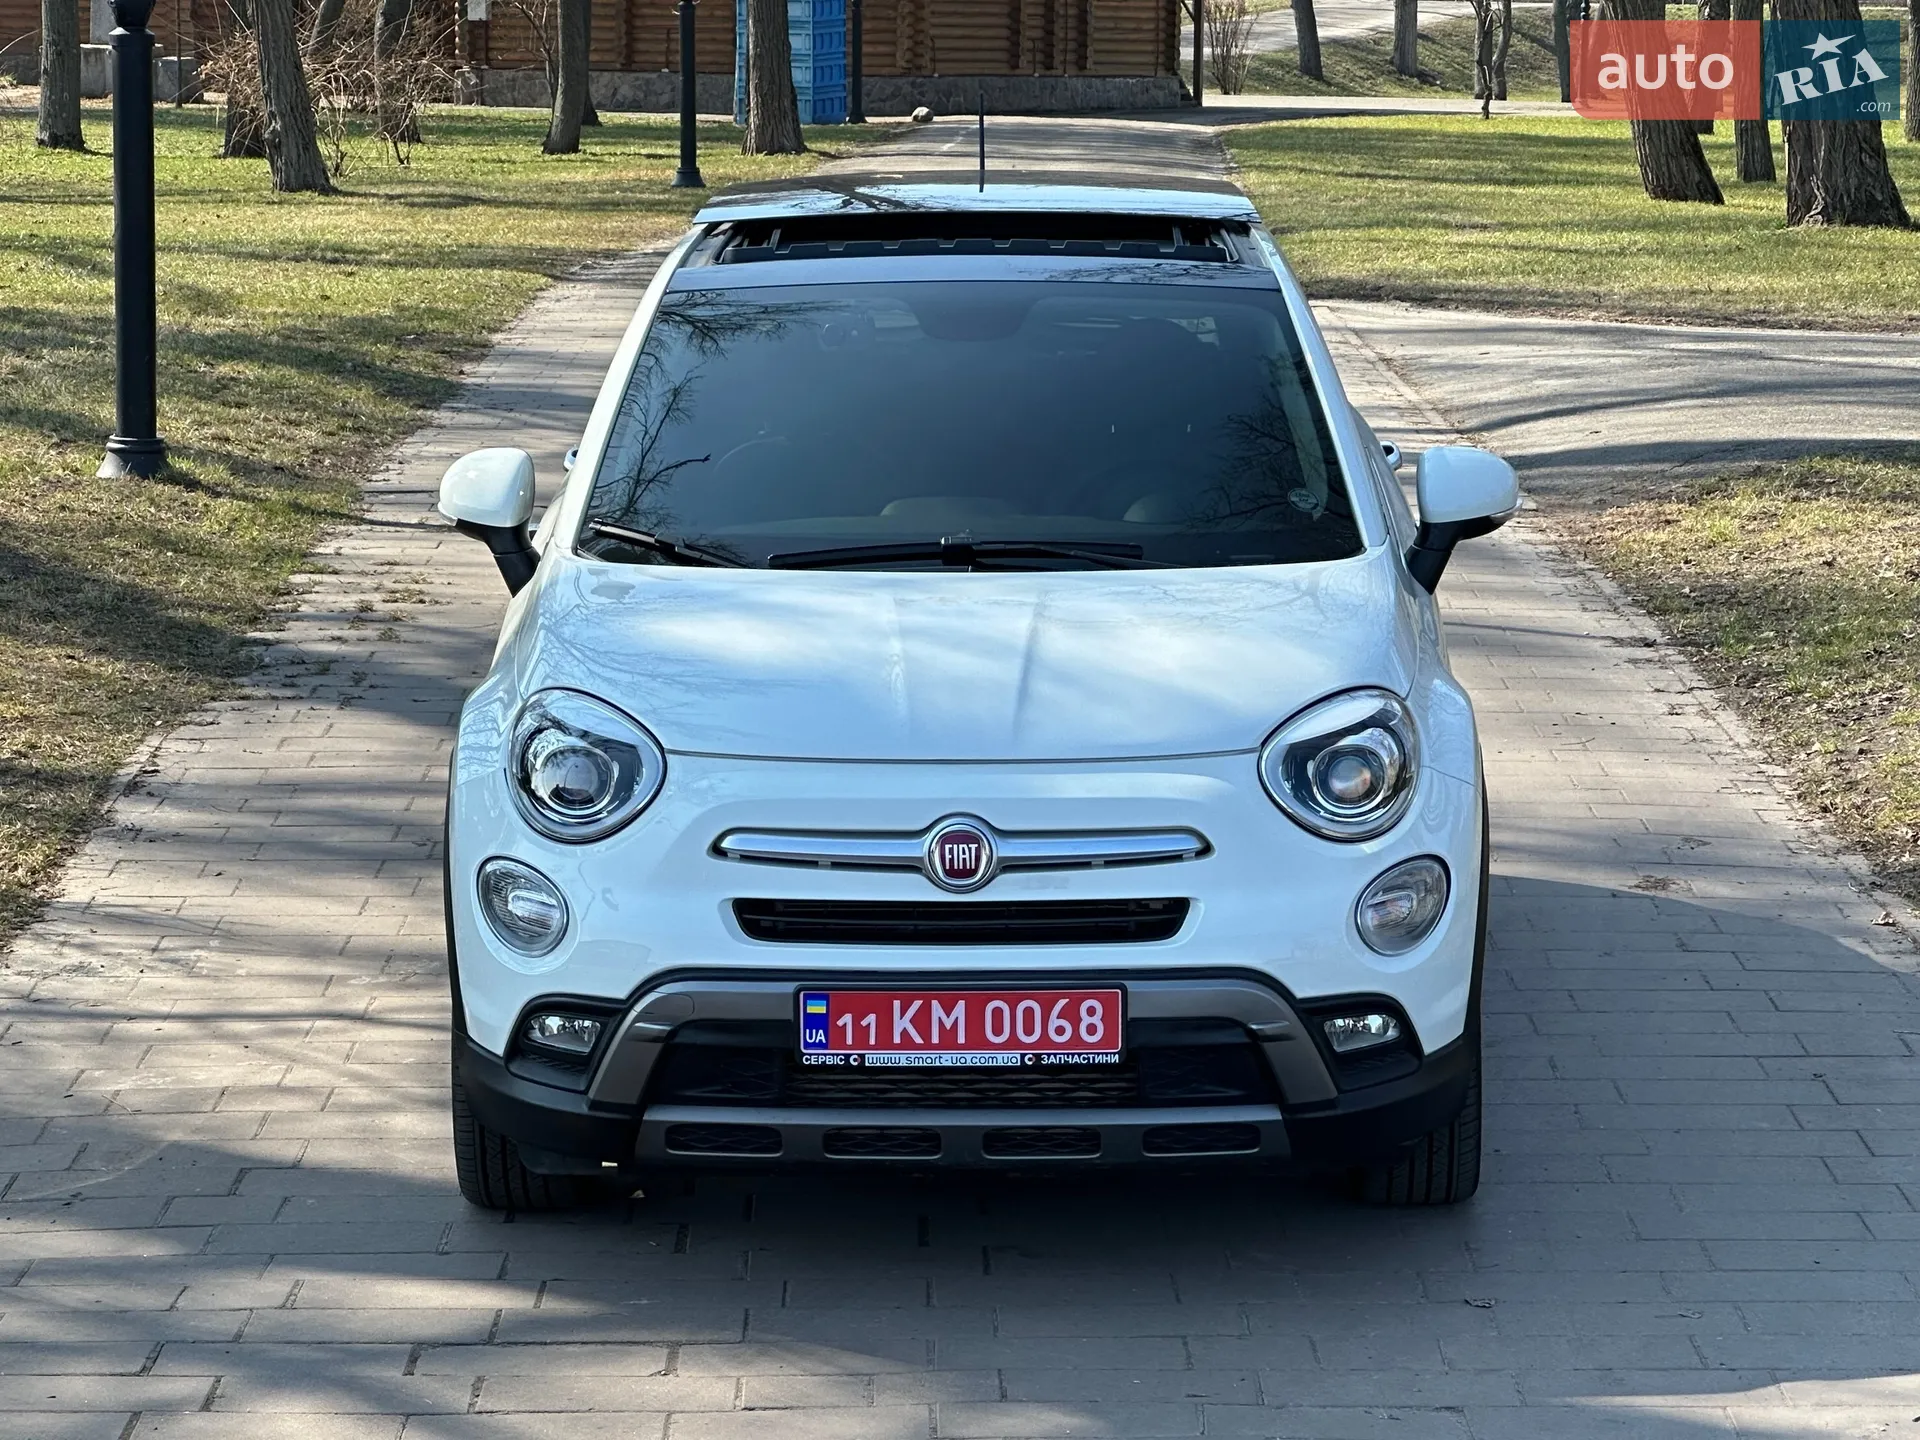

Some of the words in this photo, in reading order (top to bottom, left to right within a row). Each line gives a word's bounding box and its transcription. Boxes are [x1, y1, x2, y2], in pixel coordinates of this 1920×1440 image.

[944, 843, 978, 870] FIAT
[836, 1013, 877, 1045] 11
[892, 999, 966, 1044] KM
[984, 998, 1104, 1044] 0068
[805, 1029, 826, 1044] UA
[802, 1055, 845, 1065] СЕРВІС
[866, 1055, 1019, 1066] www.smart-ua.com.ua
[1040, 1054, 1119, 1064] ЗАПЧАСТИНИ
